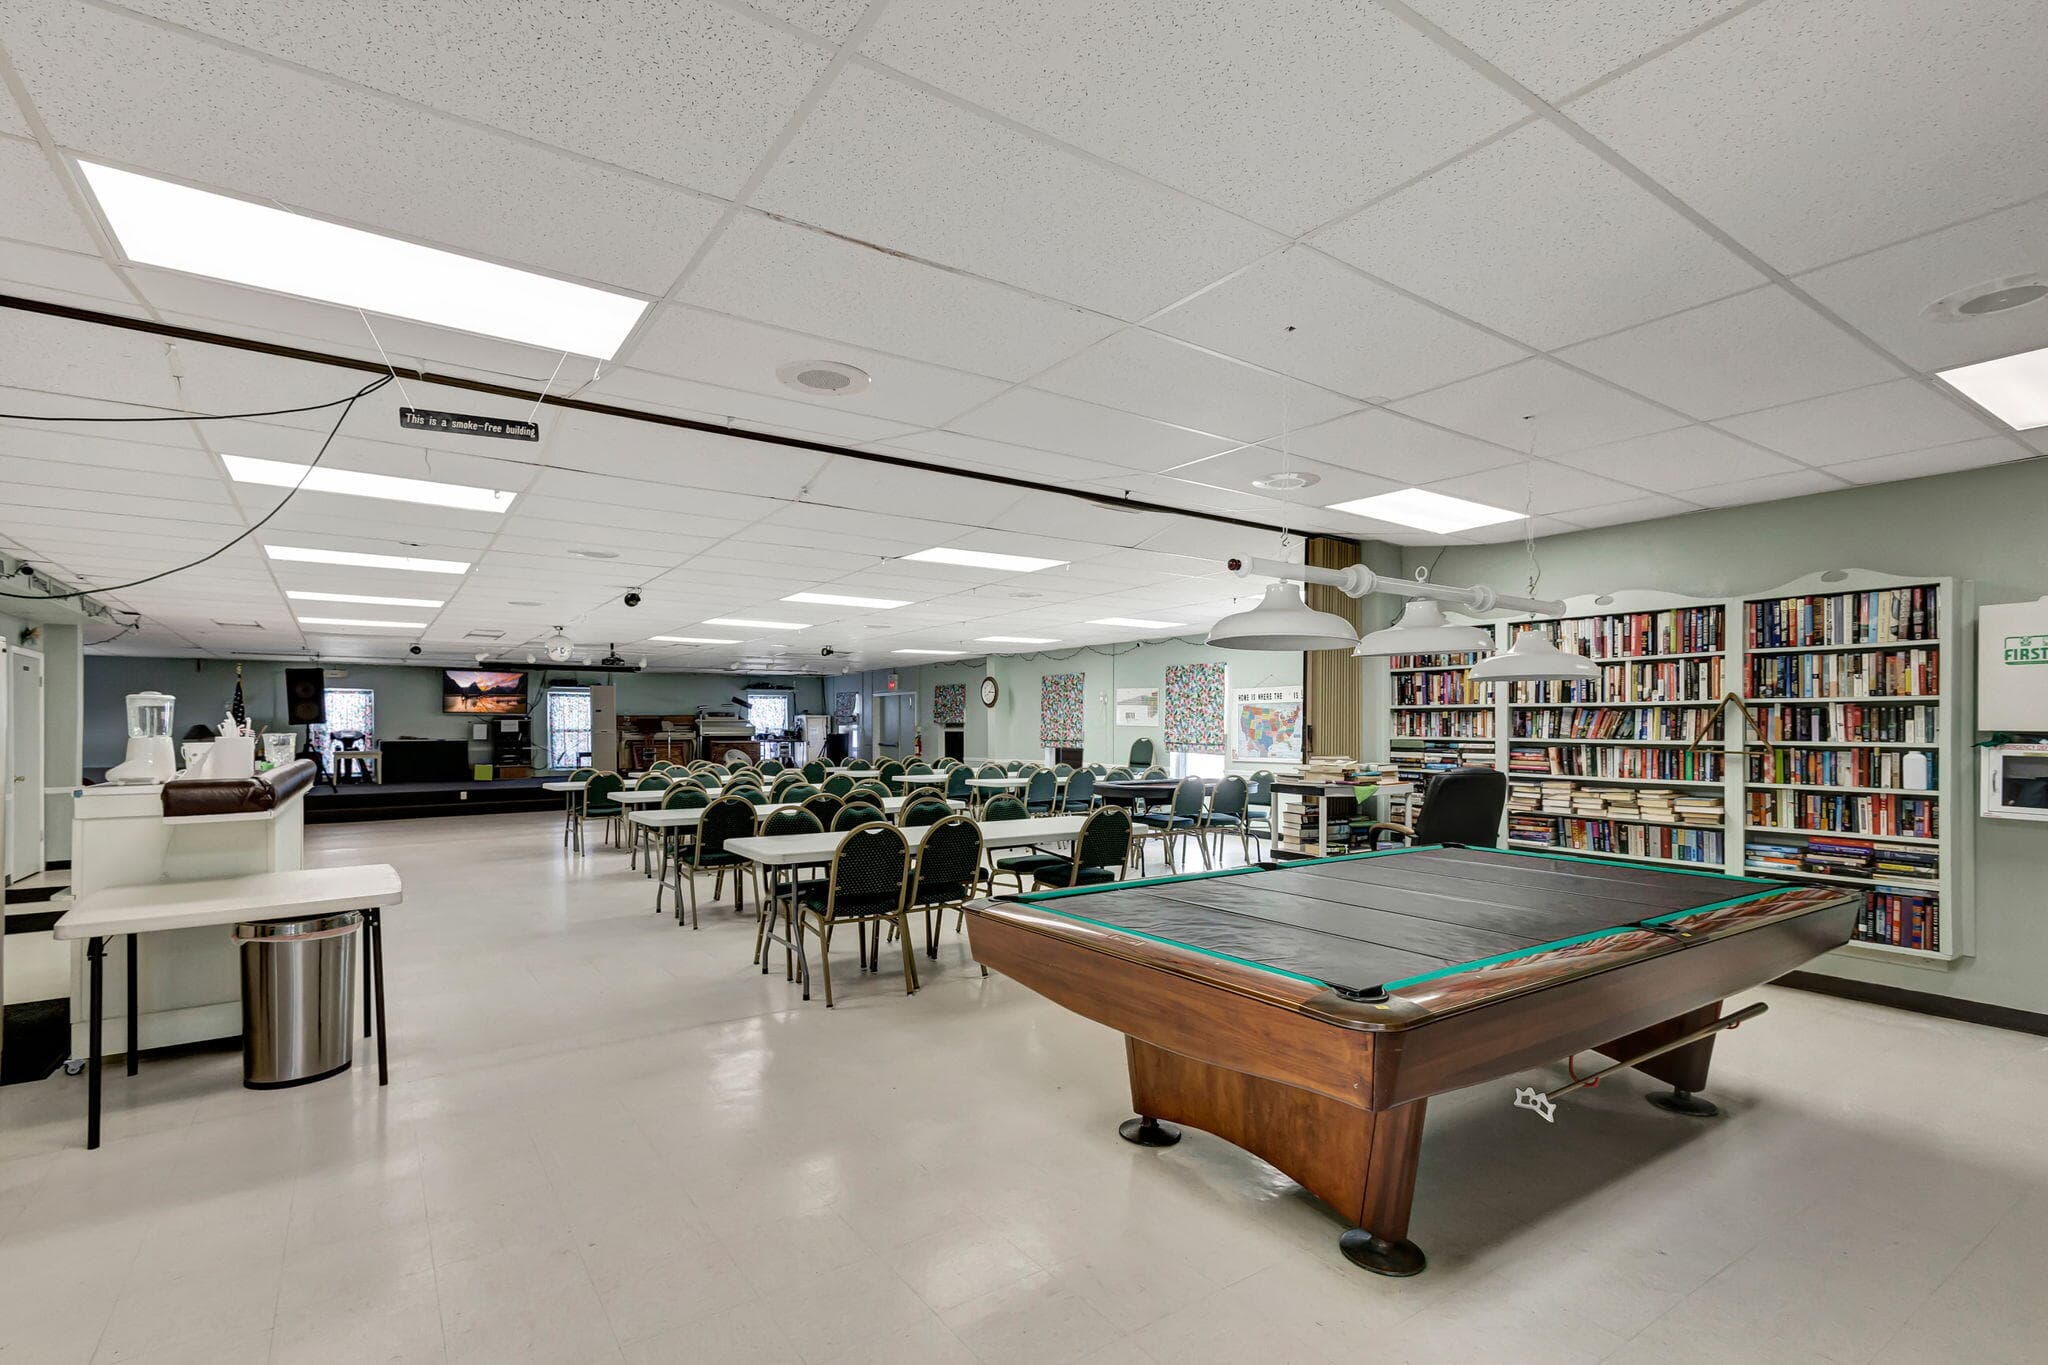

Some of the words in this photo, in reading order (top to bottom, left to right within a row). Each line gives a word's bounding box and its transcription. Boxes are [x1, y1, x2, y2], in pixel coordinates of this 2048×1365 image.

[406, 413, 425, 425] This
[429, 415, 437, 426] is
[441, 419, 447, 427] a
[452, 420, 502, 433] smoke-free
[505, 425, 536, 438] building
[2004, 647, 2048, 661] FIRST
